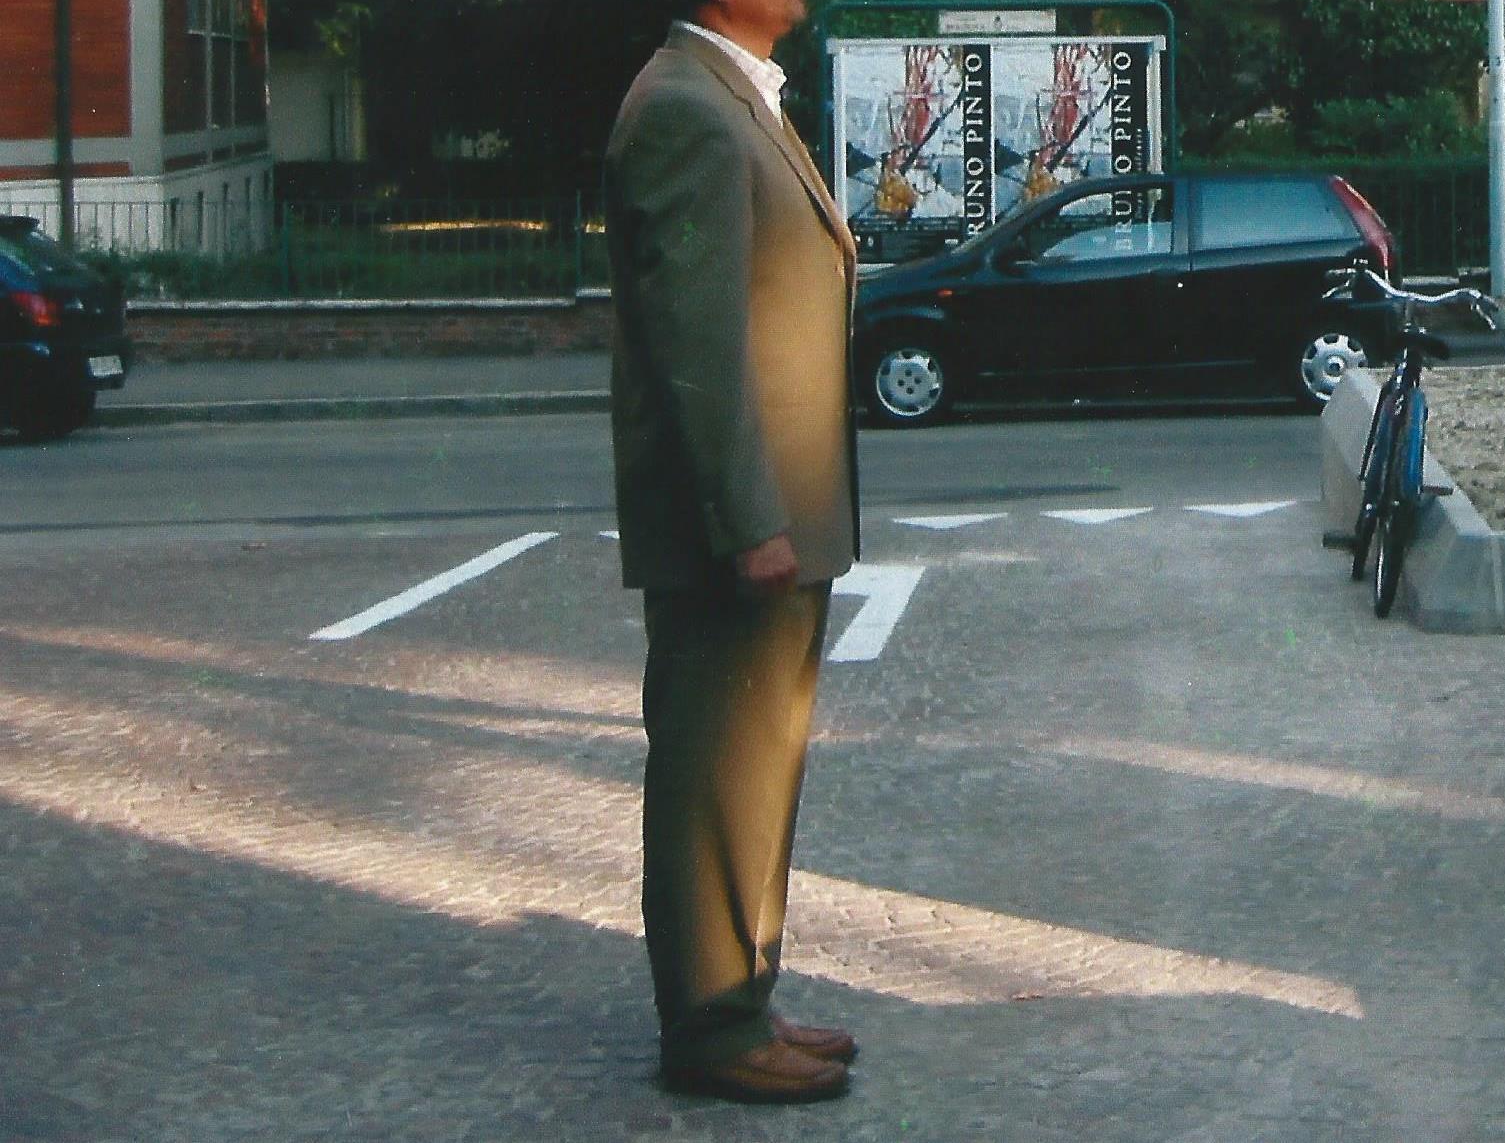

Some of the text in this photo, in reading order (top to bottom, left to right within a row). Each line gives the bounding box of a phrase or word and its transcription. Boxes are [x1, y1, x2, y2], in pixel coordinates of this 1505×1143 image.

[965, 53, 984, 235] RUNO PINTO
[1114, 51, 1132, 250] BRUO PINTO
